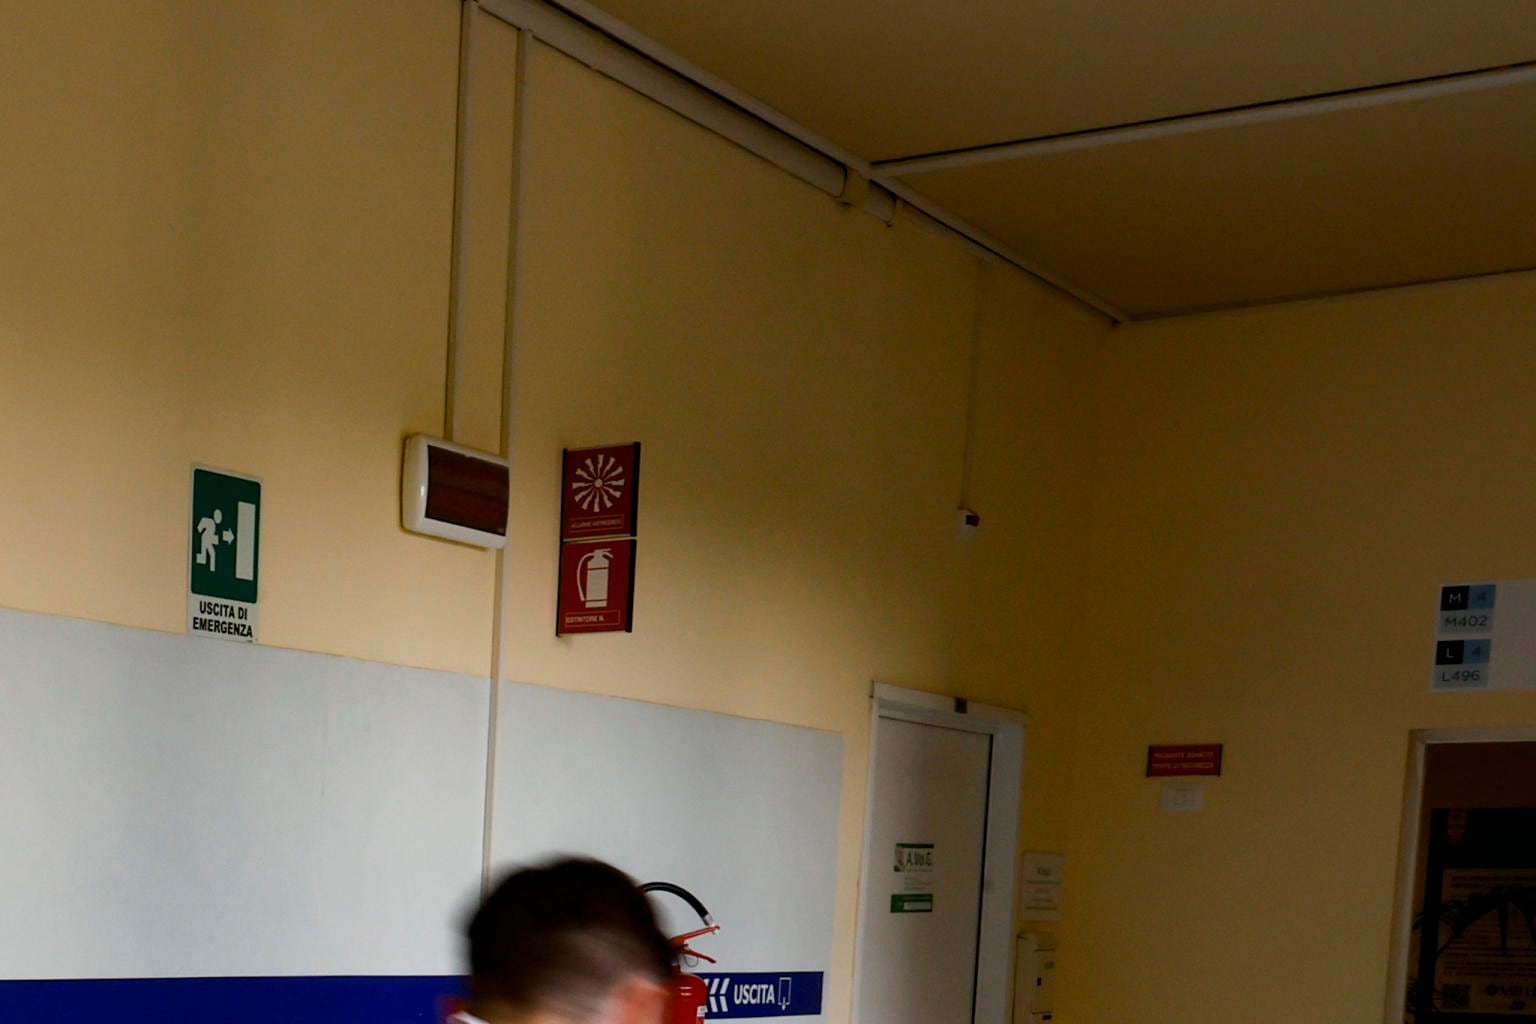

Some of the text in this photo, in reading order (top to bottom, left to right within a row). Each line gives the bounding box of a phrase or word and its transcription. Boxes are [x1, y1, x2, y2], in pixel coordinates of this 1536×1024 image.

[1449, 592, 1462, 604] M
[199, 600, 248, 620] USCITA DI
[193, 616, 253, 638] EMERGENZA
[1444, 615, 1489, 628] M402
[1445, 645, 1482, 659] L 4
[1440, 670, 1481, 682] L496
[733, 983, 776, 1006] USCITA
